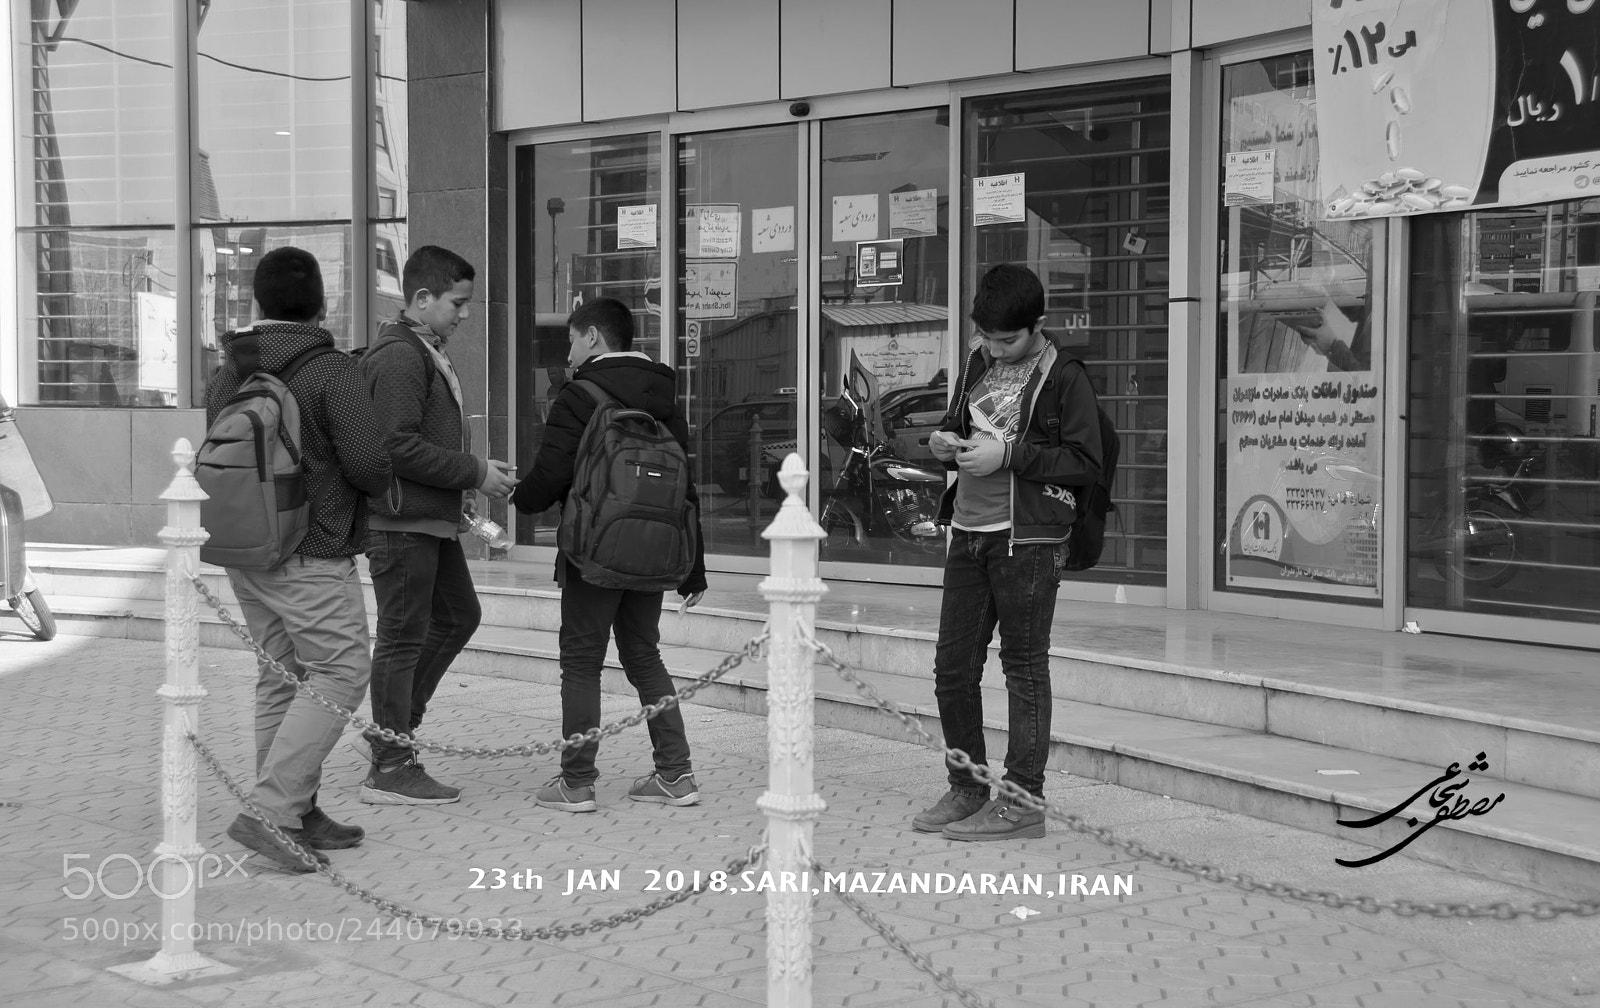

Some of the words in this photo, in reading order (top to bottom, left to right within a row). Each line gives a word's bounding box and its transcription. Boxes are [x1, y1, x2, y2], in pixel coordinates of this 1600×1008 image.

[1507, 94, 1560, 127] ریال
[1275, 122, 1294, 142] شما
[1242, 155, 1259, 166] اطلاعیه
[1568, 160, 1590, 172] کشور
[1539, 164, 1567, 174] مراجعه
[990, 179, 1007, 188] اطلاعیه
[839, 202, 854, 233] شعبه
[851, 211, 876, 228] ورودی
[757, 214, 771, 244] شعبه
[769, 223, 792, 239] ورودی
[1232, 387, 1260, 402] مازندران
[1262, 387, 1289, 402] صادرات
[1291, 385, 1308, 403] بانک
[1312, 381, 1341, 399] امانات
[1343, 383, 1377, 404] صندوق
[1258, 410, 1276, 426] ساری
[1279, 410, 1293, 430] امام
[1295, 410, 1315, 427] میدان
[1318, 410, 1336, 427] شعبه
[1337, 412, 1348, 426] در
[1349, 410, 1375, 427] مستقر
[1239, 435, 1258, 452] محترم
[1260, 434, 1287, 450] مشتریان
[1289, 437, 1297, 451] به
[1299, 434, 1326, 447] خدمات
[1346, 432, 1367, 448] آماده
[1285, 458, 1304, 475] باشد
[1306, 463, 1318, 475] می
